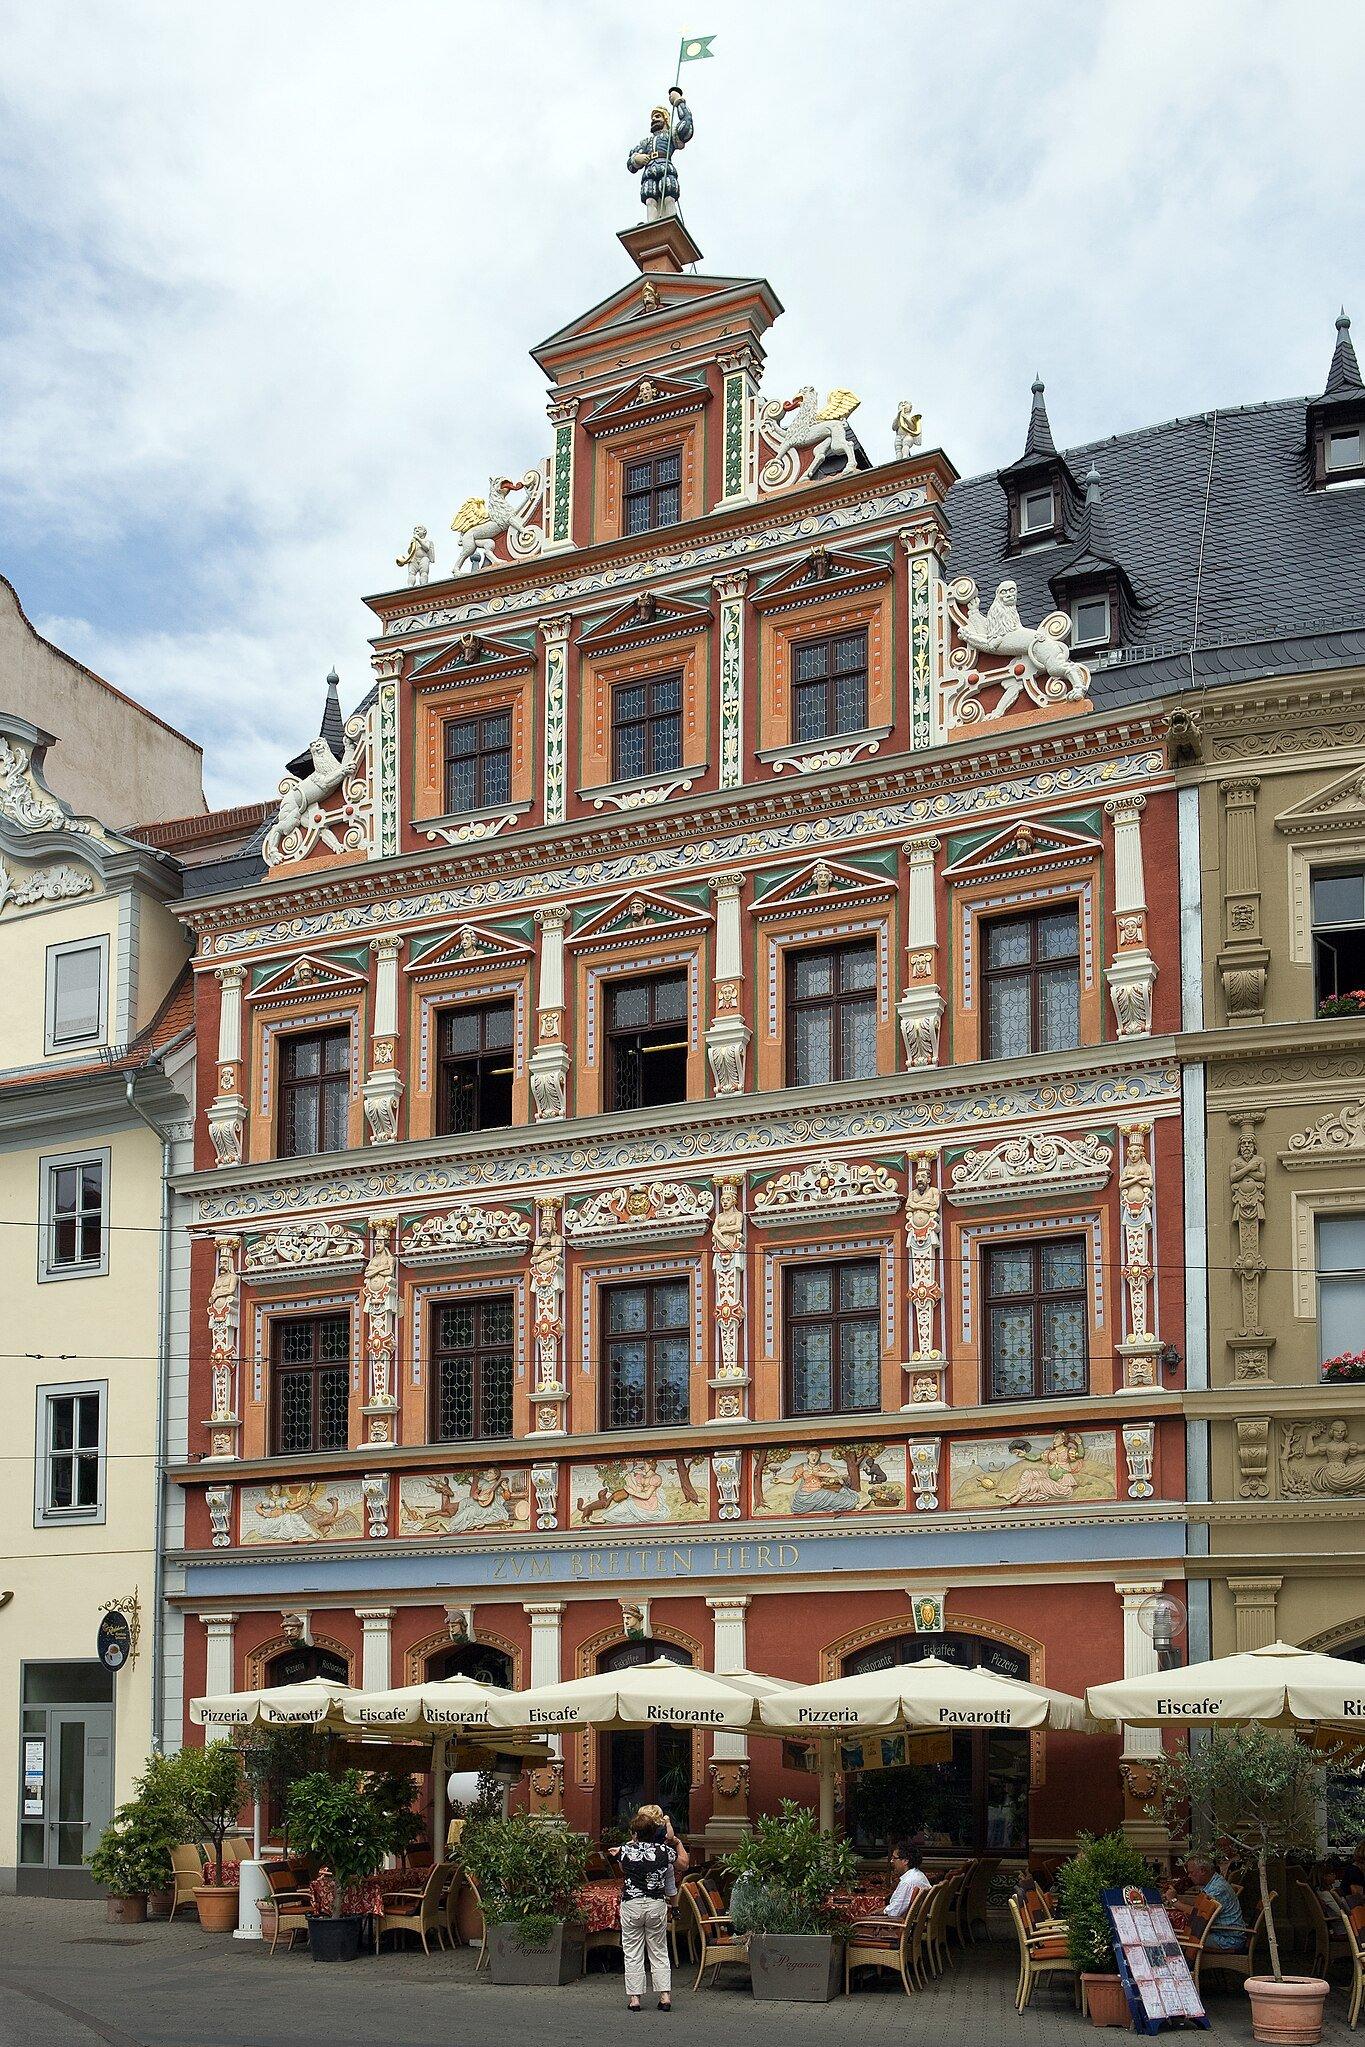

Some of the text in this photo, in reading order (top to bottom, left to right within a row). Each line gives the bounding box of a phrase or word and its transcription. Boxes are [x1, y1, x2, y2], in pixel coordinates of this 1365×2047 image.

[570, 1549, 693, 1576] BREITEN
[713, 1544, 800, 1571] HERD
[923, 1644, 956, 1657] Eiskaffee
[990, 1652, 1019, 1674] Pizzeria
[200, 1708, 324, 1722] Pizzeria Pavarotti
[426, 1708, 488, 1722] Ristorant
[647, 1705, 725, 1722] Ristorante
[798, 1707, 1011, 1723] Pizzeria Pavarotti
